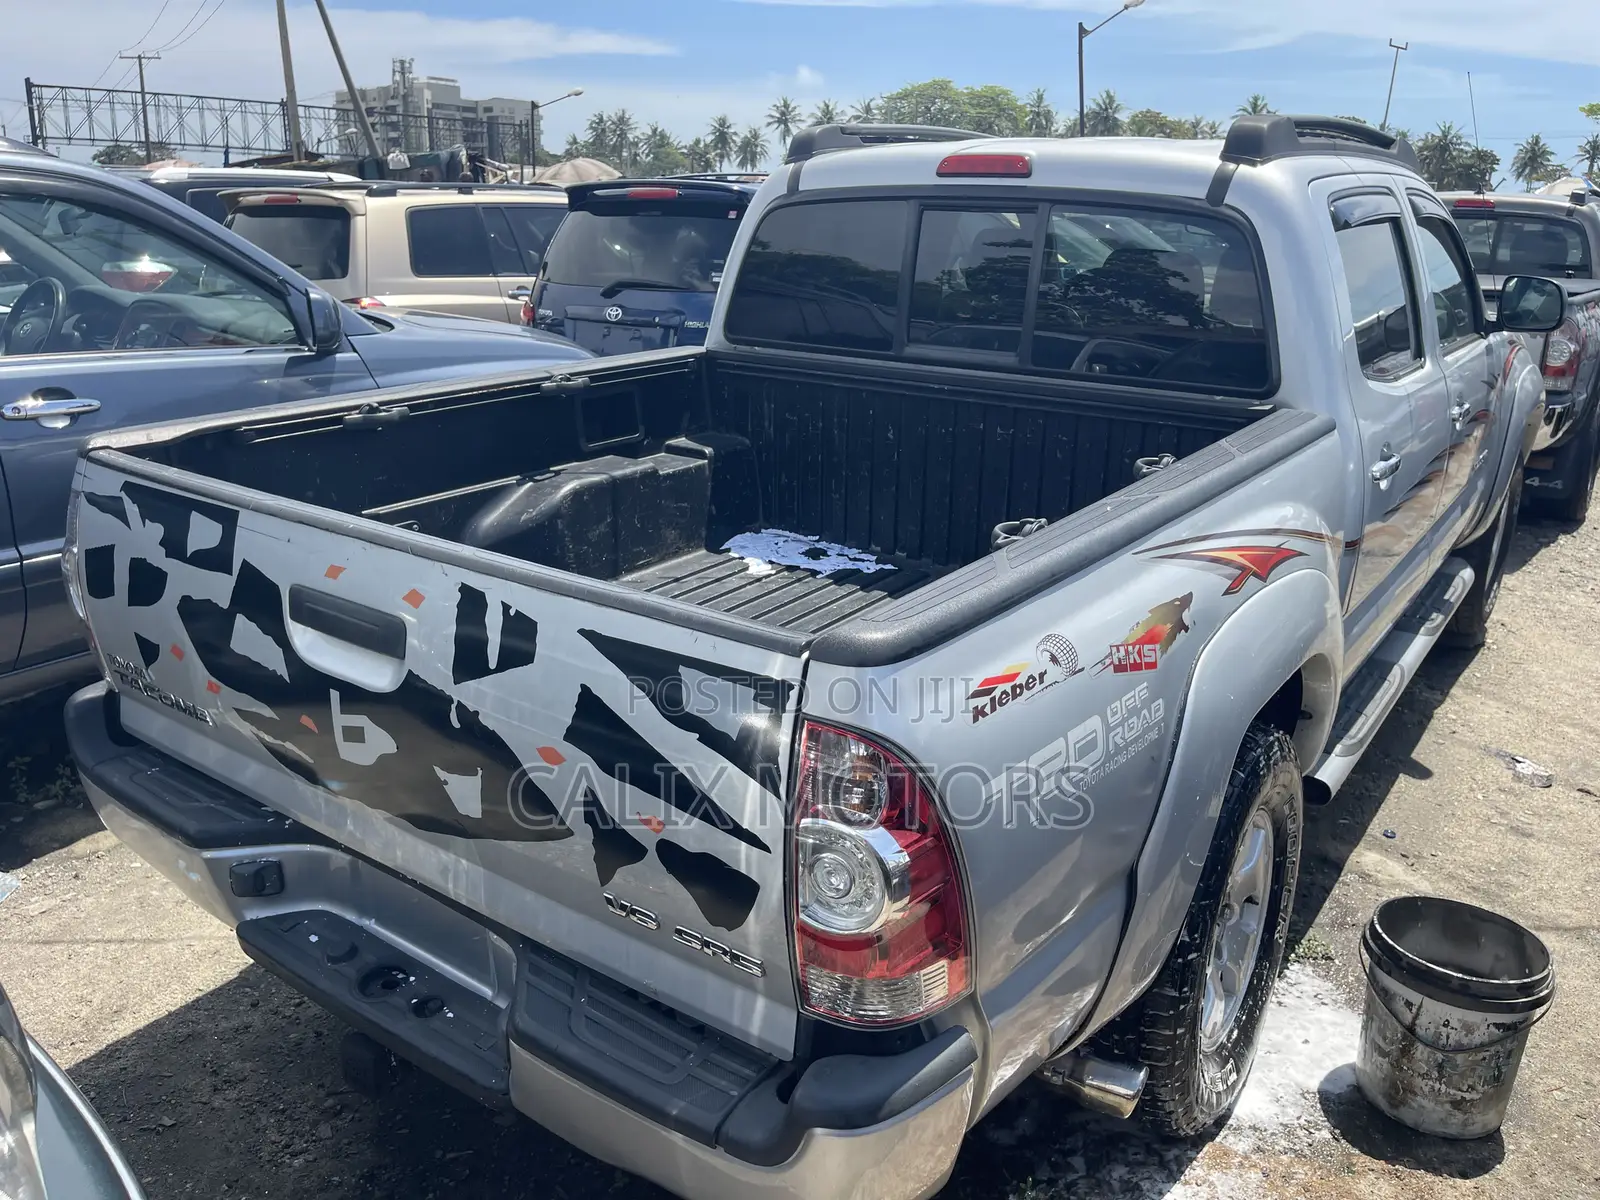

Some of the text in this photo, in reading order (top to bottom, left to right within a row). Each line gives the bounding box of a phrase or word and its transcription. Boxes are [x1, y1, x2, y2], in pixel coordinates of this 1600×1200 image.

[107, 653, 154, 683] TOYOTA
[1111, 644, 1157, 666] HKS
[113, 669, 214, 727] TACOMA
[972, 669, 1047, 724] Kleber
[1107, 682, 1149, 727] OFF
[1109, 697, 1165, 754] ROAD
[1079, 722, 1165, 793] TOYOTA RACING DEVELOPMET
[603, 891, 766, 979] V6 SR5
